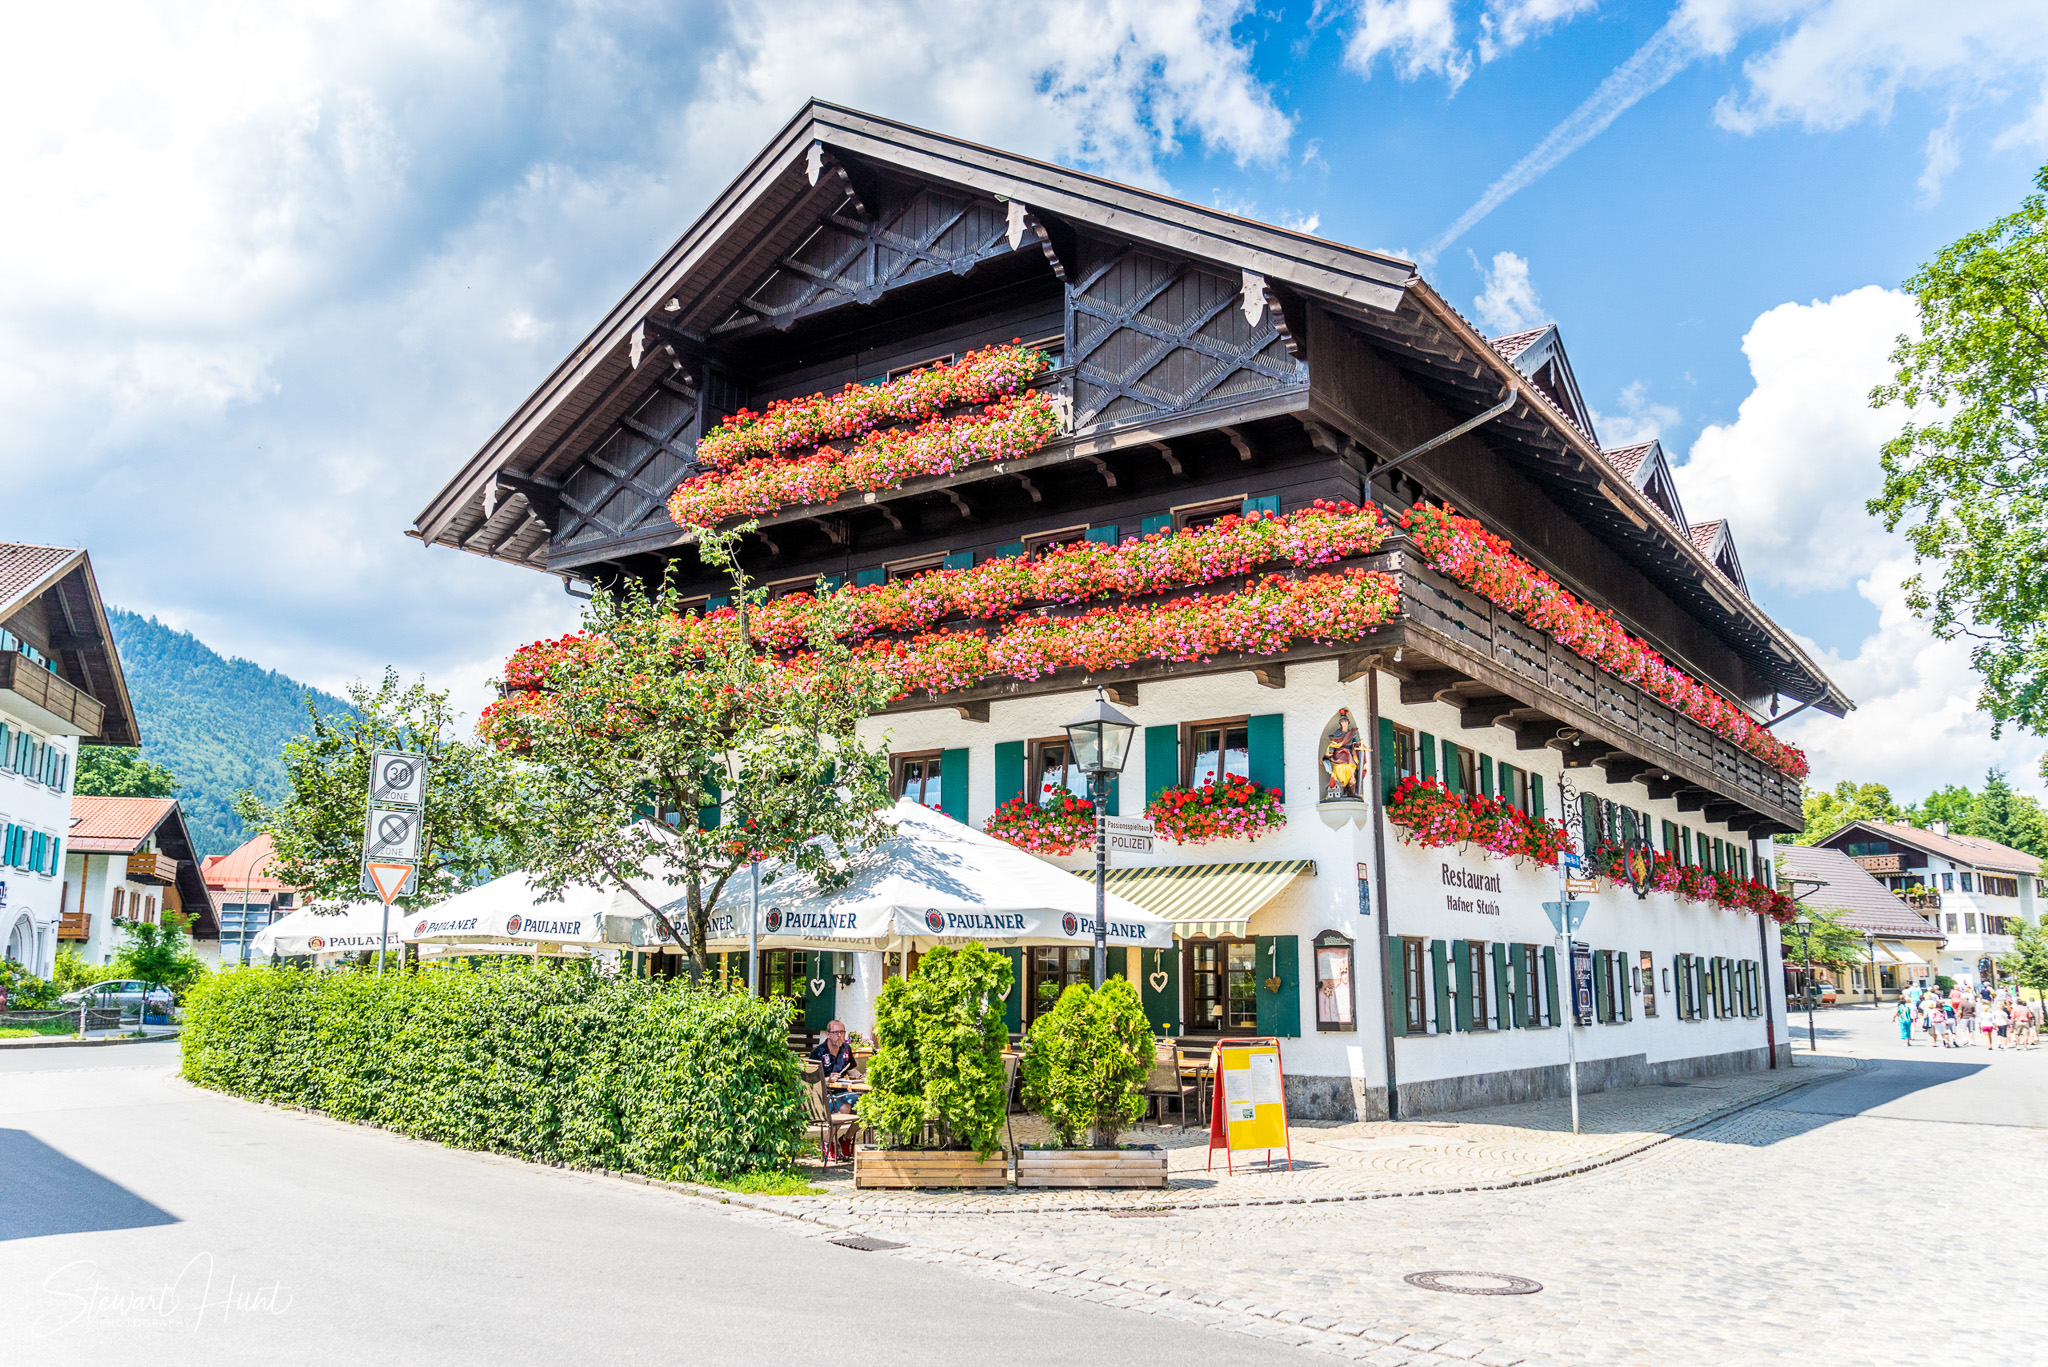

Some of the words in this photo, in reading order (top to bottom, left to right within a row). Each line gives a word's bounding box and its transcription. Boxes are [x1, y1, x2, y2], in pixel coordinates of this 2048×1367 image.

[390, 767, 408, 781] 30
[385, 791, 408, 801] ZONE
[1107, 821, 1149, 832] Passionsspielhaus
[1111, 836, 1146, 849] POLIZEI
[380, 847, 403, 856] ZONE
[1442, 863, 1501, 893] Restaurant
[1447, 895, 1473, 913] Hafner
[426, 918, 478, 933] PAULANER
[523, 919, 581, 935] PAULANER
[674, 915, 734, 935] PAANER
[785, 912, 857, 929] PAULANER
[946, 913, 1026, 929] PAULANER
[1080, 917, 1147, 939] PALANER
